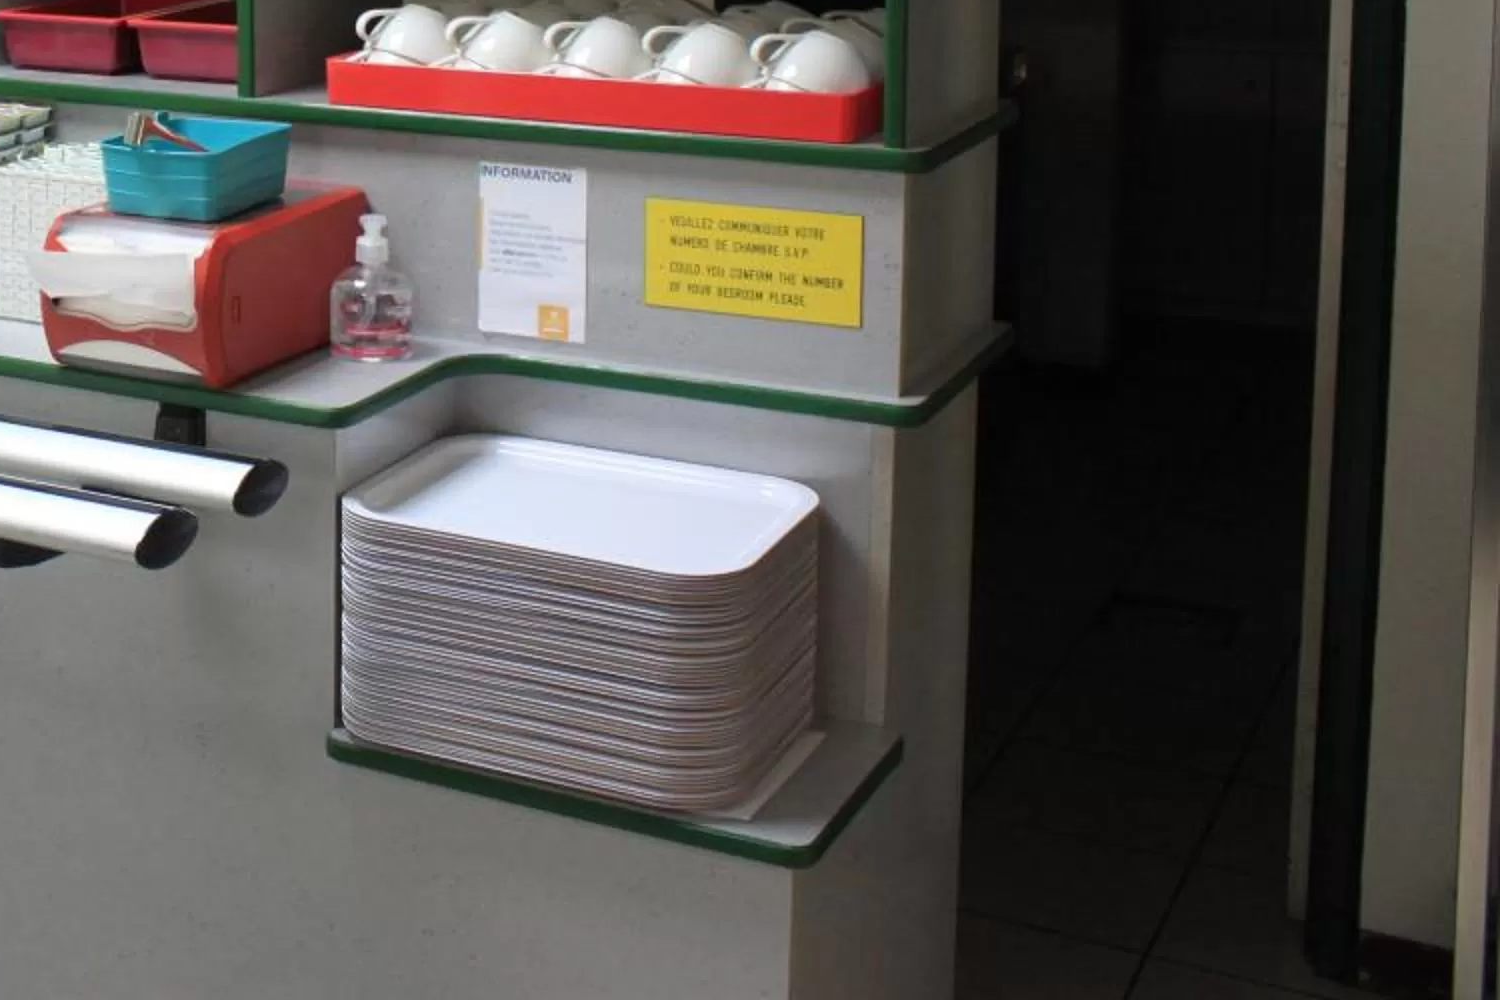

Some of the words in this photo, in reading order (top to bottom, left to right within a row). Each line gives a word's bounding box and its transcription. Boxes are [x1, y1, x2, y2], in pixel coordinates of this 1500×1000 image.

[715, 239, 729, 251] DE
[733, 240, 781, 257] CHAMBRE
[669, 261, 701, 276] COULD
[706, 264, 725, 278] YOU
[729, 265, 774, 281] CONFIRM
[779, 271, 797, 286] THE
[802, 274, 844, 290] NUMBER
[769, 291, 805, 307] PLEASE
